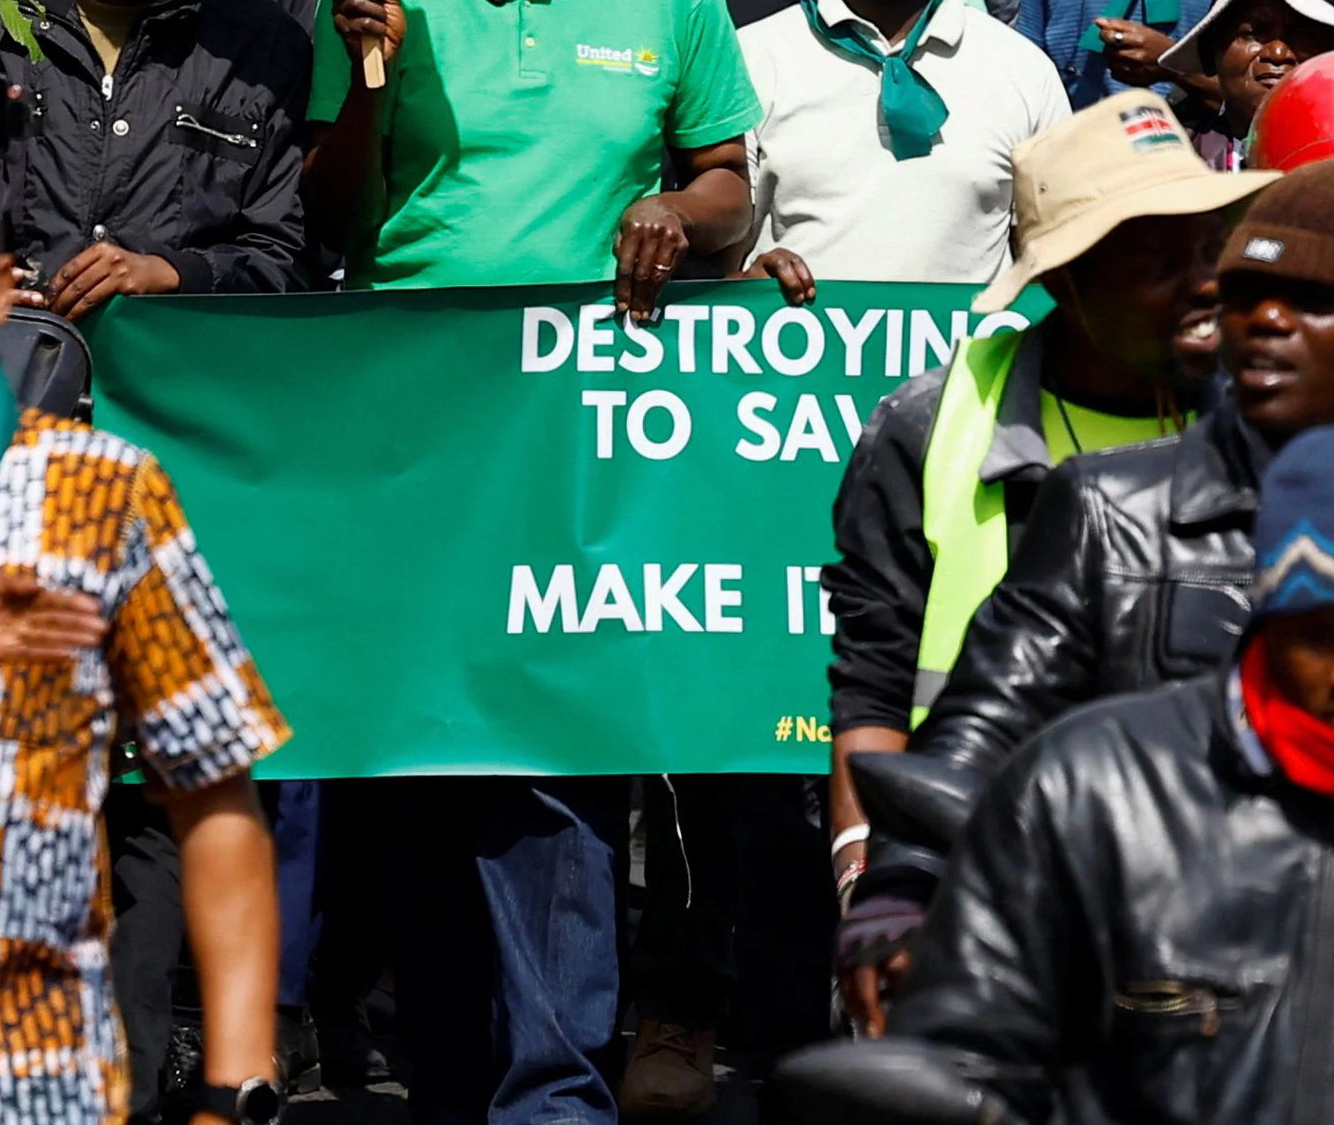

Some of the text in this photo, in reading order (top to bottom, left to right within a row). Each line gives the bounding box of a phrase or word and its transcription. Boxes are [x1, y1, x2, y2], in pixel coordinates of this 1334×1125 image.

[576, 44, 633, 62] United
[581, 389, 693, 461] TO
[506, 562, 744, 635] MAKE
